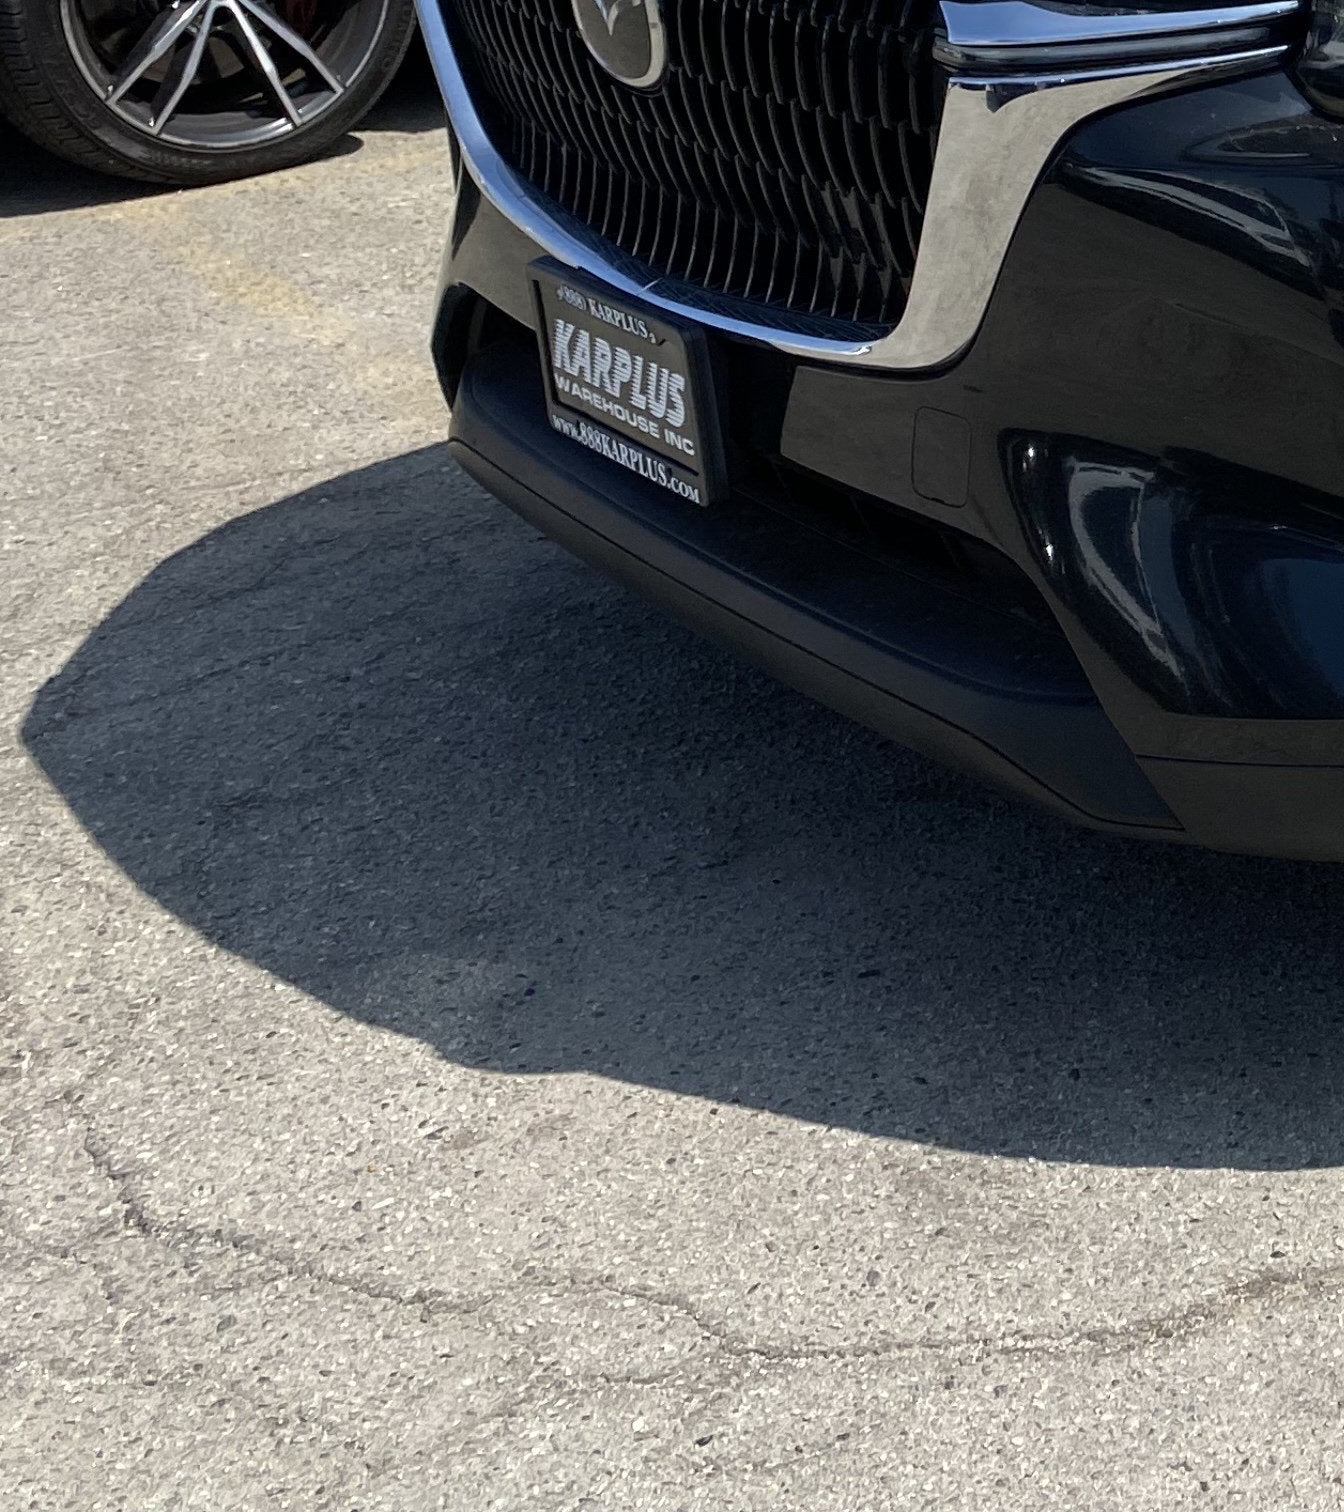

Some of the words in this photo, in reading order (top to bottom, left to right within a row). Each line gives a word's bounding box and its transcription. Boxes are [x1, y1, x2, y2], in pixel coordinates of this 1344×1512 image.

[587, 298, 648, 339] KARPLUS
[553, 318, 685, 428] KARPLUS
[554, 372, 660, 439] WAREHOUSE
[664, 428, 695, 456] INC
